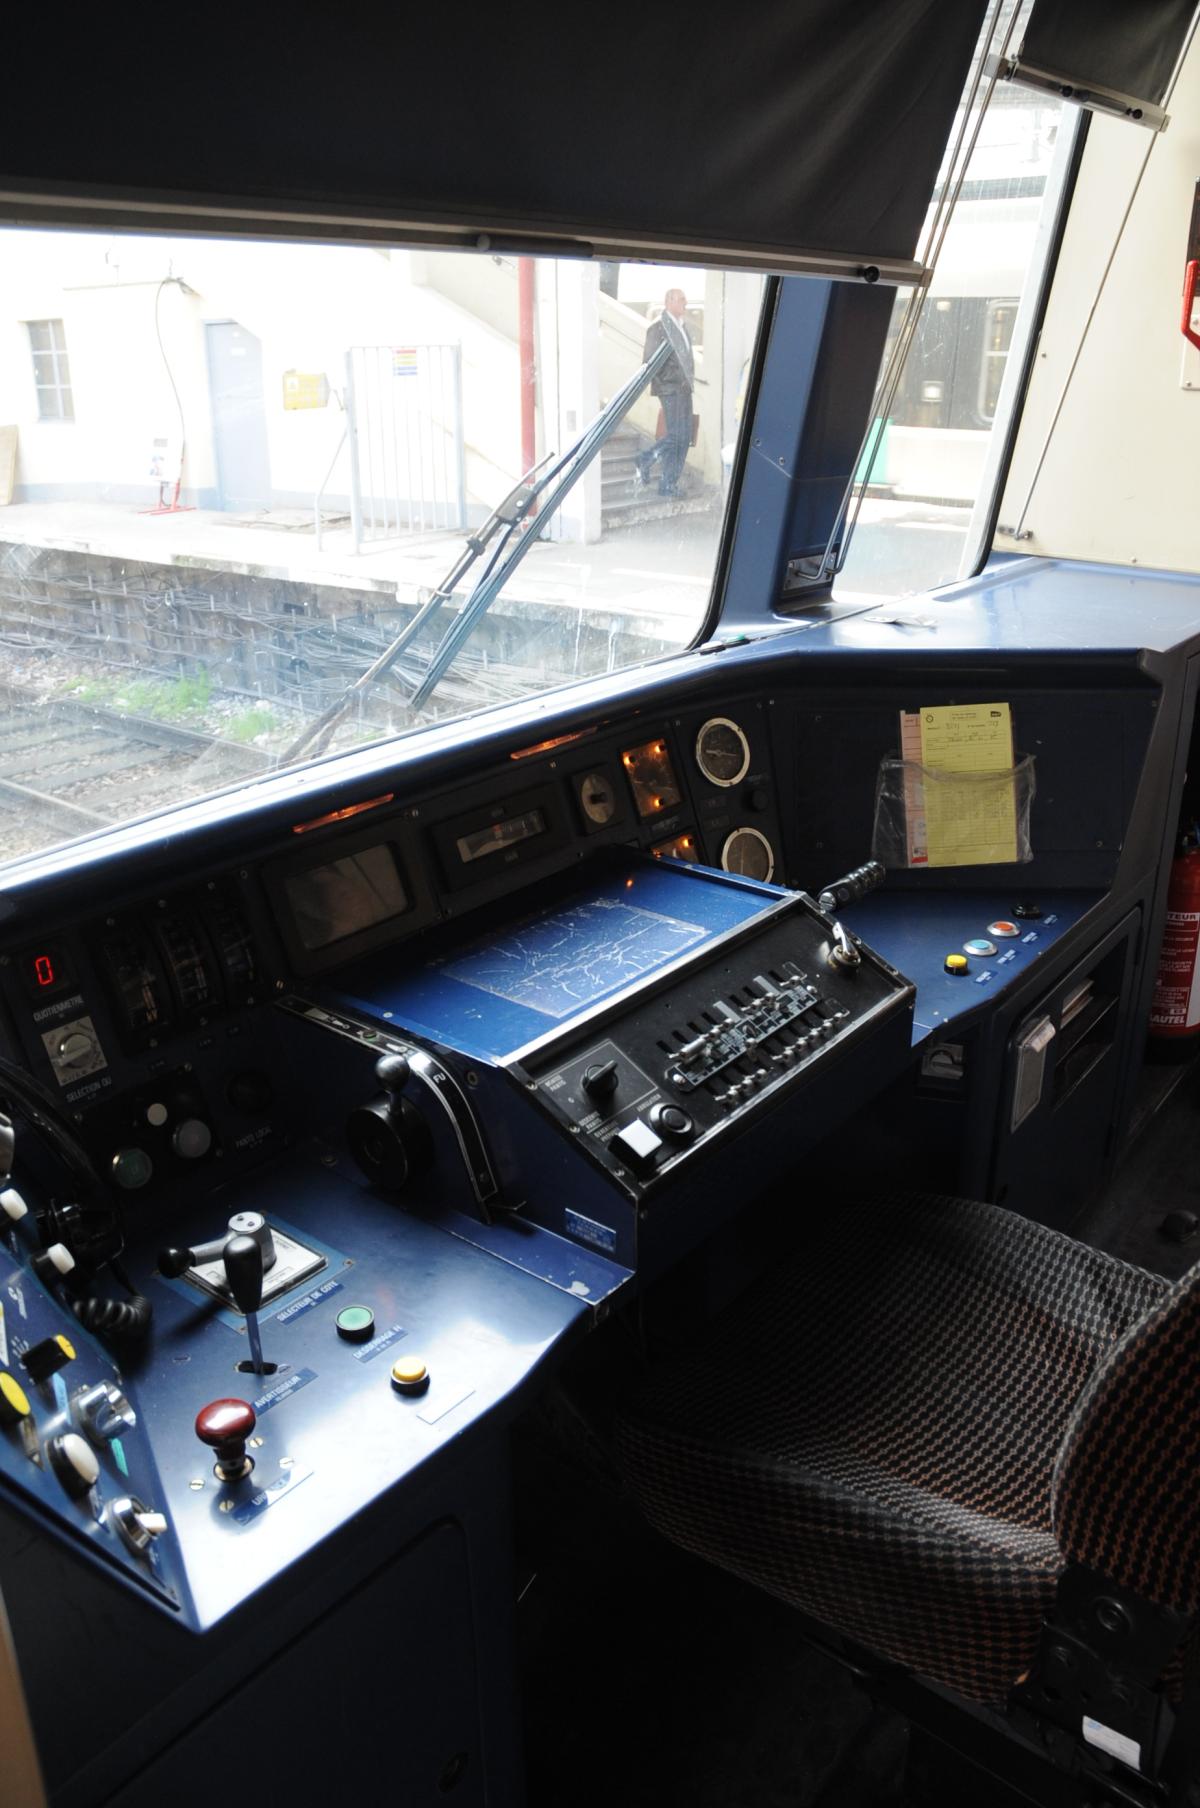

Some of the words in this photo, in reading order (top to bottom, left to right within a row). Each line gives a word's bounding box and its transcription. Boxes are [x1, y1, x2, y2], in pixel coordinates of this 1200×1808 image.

[35, 956, 54, 985] 0
[310, 1290, 323, 1301] DE
[254, 1375, 302, 1408] AVERTISSEUR
